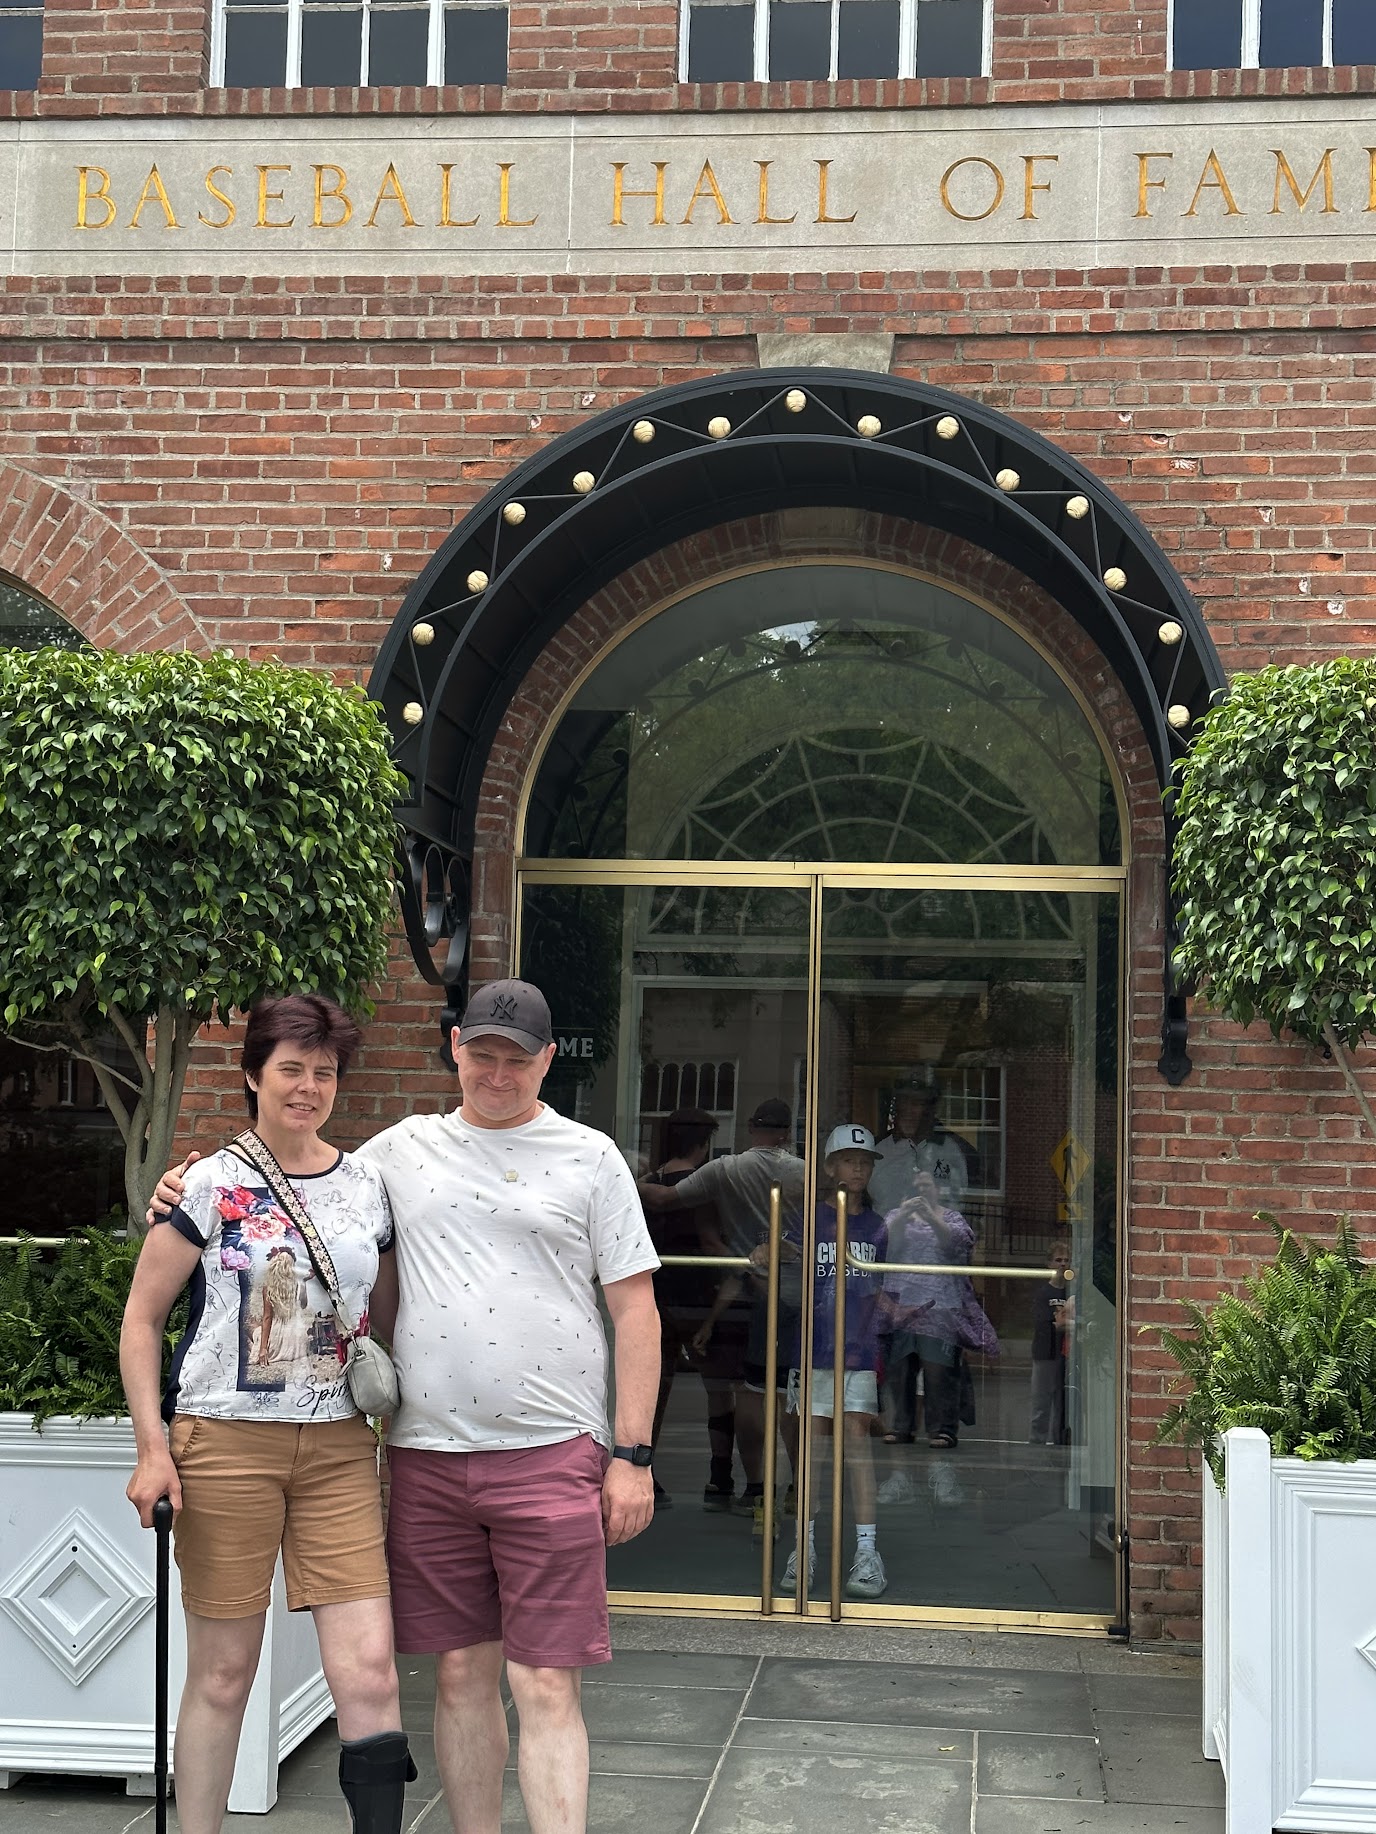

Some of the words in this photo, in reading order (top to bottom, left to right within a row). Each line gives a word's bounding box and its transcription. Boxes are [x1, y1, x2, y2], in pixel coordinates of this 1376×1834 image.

[73, 161, 539, 230] BASEBALL
[608, 157, 858, 227] HALL
[940, 154, 1060, 221] OF
[490, 993, 518, 1021] NY
[851, 1128, 865, 1144] C
